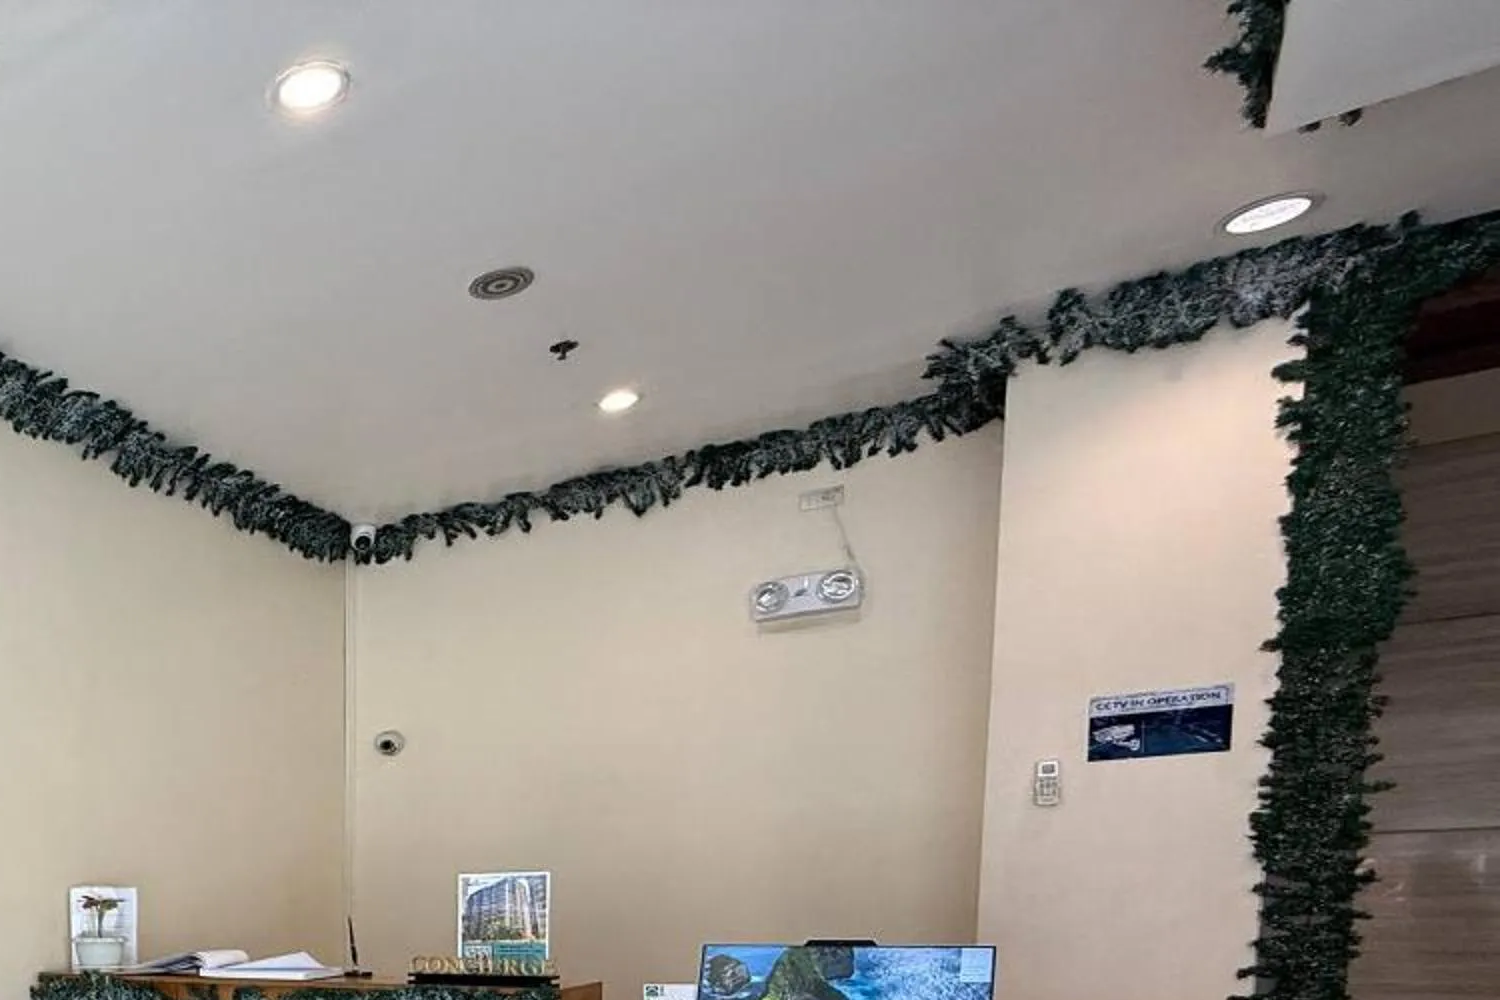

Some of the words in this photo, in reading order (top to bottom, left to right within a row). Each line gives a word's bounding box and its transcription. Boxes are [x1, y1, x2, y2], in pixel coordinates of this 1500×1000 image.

[1095, 701, 1128, 711] CCTV
[1147, 692, 1221, 705] OPERATION
[411, 956, 557, 975] CONCIERGE
